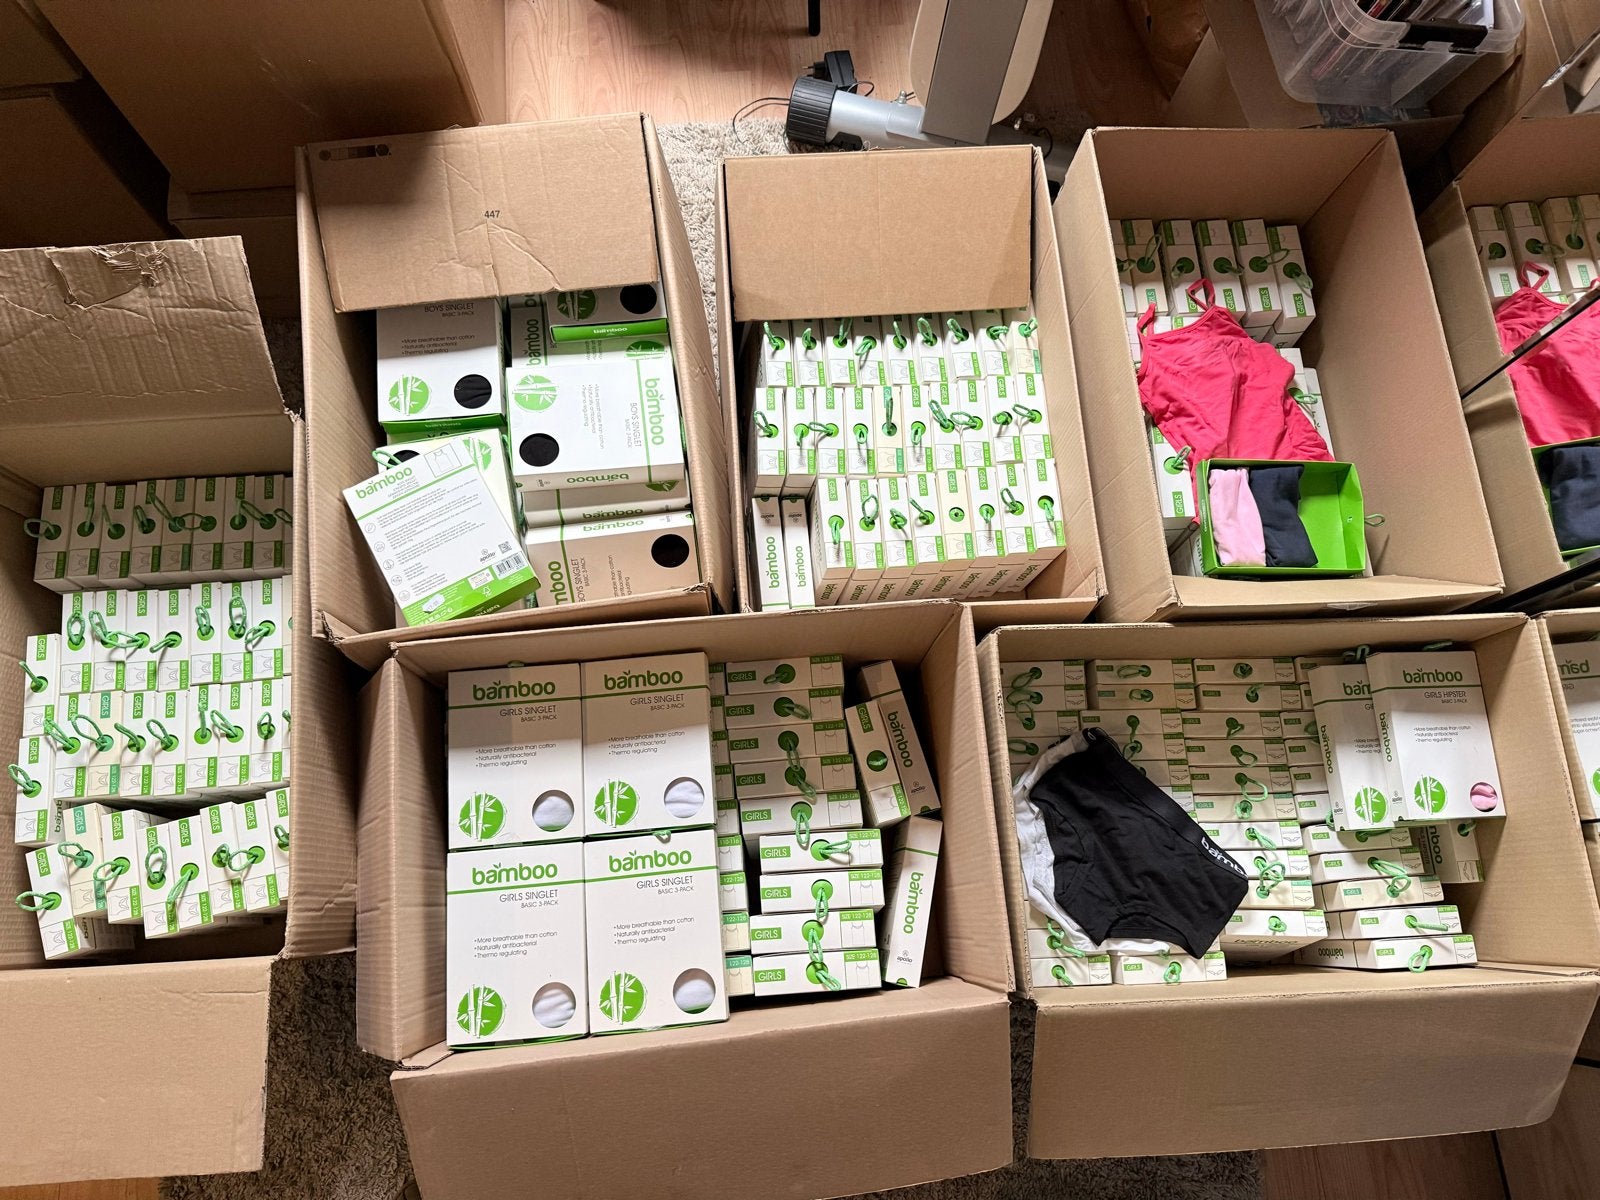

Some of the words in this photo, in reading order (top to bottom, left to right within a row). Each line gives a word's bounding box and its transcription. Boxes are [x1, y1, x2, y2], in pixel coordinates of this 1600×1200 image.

[484, 209, 501, 219] 447
[424, 303, 444, 313] BOYS
[445, 302, 475, 312] SINGLET
[1224, 290, 1235, 310] GIRLS
[1260, 289, 1271, 310] GIRLS
[1294, 295, 1305, 315] GIRLS
[525, 318, 542, 366] bamboo
[644, 377, 665, 446] bamboo
[355, 467, 413, 499] bamboo
[566, 473, 630, 484] bamboo
[582, 508, 644, 519] bamboo
[1174, 494, 1184, 514] GIRLS
[583, 519, 645, 532] bamboo
[571, 558, 583, 584] SINGLET
[765, 536, 780, 589] bamboo
[795, 545, 807, 588] bamboo
[202, 586, 210, 607] GIRLS
[263, 582, 271, 602] GIRLS
[107, 593, 115, 614] GIRLS
[138, 593, 146, 614] GIRLS
[169, 593, 177, 613] GIRLS
[37, 638, 46, 658] GIRLS
[604, 669, 683, 691] bamboo
[731, 672, 753, 681] GIRLS
[1403, 668, 1463, 684] bamboo
[263, 683, 271, 704] GIRLS
[473, 680, 556, 701] bamboo
[630, 695, 651, 706] GIRLS
[653, 693, 684, 704] SINGLET
[101, 695, 110, 716] GIRLS
[134, 695, 142, 717] GIRLS
[166, 694, 174, 716] GIRLS
[500, 706, 523, 717] GIRLS
[524, 704, 557, 715] SINGLET
[666, 702, 685, 710] 3-PACK
[729, 706, 751, 715] GIRLS
[857, 707, 871, 731] GIRLS
[611, 742, 634, 750] Naturally
[635, 739, 666, 747] antibacterial
[625, 733, 653, 741] breathable
[733, 740, 755, 749] GIRLS
[887, 711, 913, 768] bamboo
[1379, 712, 1392, 762] bamboo
[30, 740, 38, 761] GIRLS
[479, 754, 502, 762] Naturally
[503, 751, 537, 760] antibacterial
[492, 745, 523, 753] breathable
[632, 747, 658, 755] regulating
[1320, 725, 1333, 774] bamboo
[500, 759, 528, 767] regulating
[739, 775, 762, 785] GIRLS
[277, 793, 287, 815] GIRLS
[75, 810, 85, 833] GIRLS
[210, 809, 220, 831] GIRLS
[245, 805, 256, 827] GIRLS
[745, 811, 768, 820] GIRLS
[113, 815, 122, 837] GIRLS
[180, 822, 190, 844] GIRLS
[608, 850, 692, 873] bamboo
[764, 848, 787, 857] GIRLS
[1201, 836, 1248, 879] bamb
[37, 852, 48, 875] GIRLS
[472, 862, 558, 886] bamboo
[636, 878, 660, 890] GIRLS
[661, 876, 693, 887] SINGLET
[499, 891, 523, 903] GIRLS
[525, 889, 558, 900] SINGLET
[658, 887, 673, 895] BASIC
[674, 885, 694, 893] 3-PACK
[764, 888, 787, 898] GIRLS
[538, 899, 558, 907] 3-PACK
[904, 871, 924, 934] bamboo
[631, 920, 662, 928] breathable
[677, 916, 695, 924] cotton
[492, 934, 524, 942] breathable
[617, 931, 639, 939] Naturally
[641, 926, 676, 935] antibacterial
[639, 935, 666, 944] regulating
[754, 929, 778, 939] GIRLS
[477, 944, 500, 952] Naturally
[502, 940, 537, 949] antibacterial
[499, 949, 528, 957] regulating
[1318, 947, 1344, 959] bamboo
[758, 971, 782, 981] GIRLS
